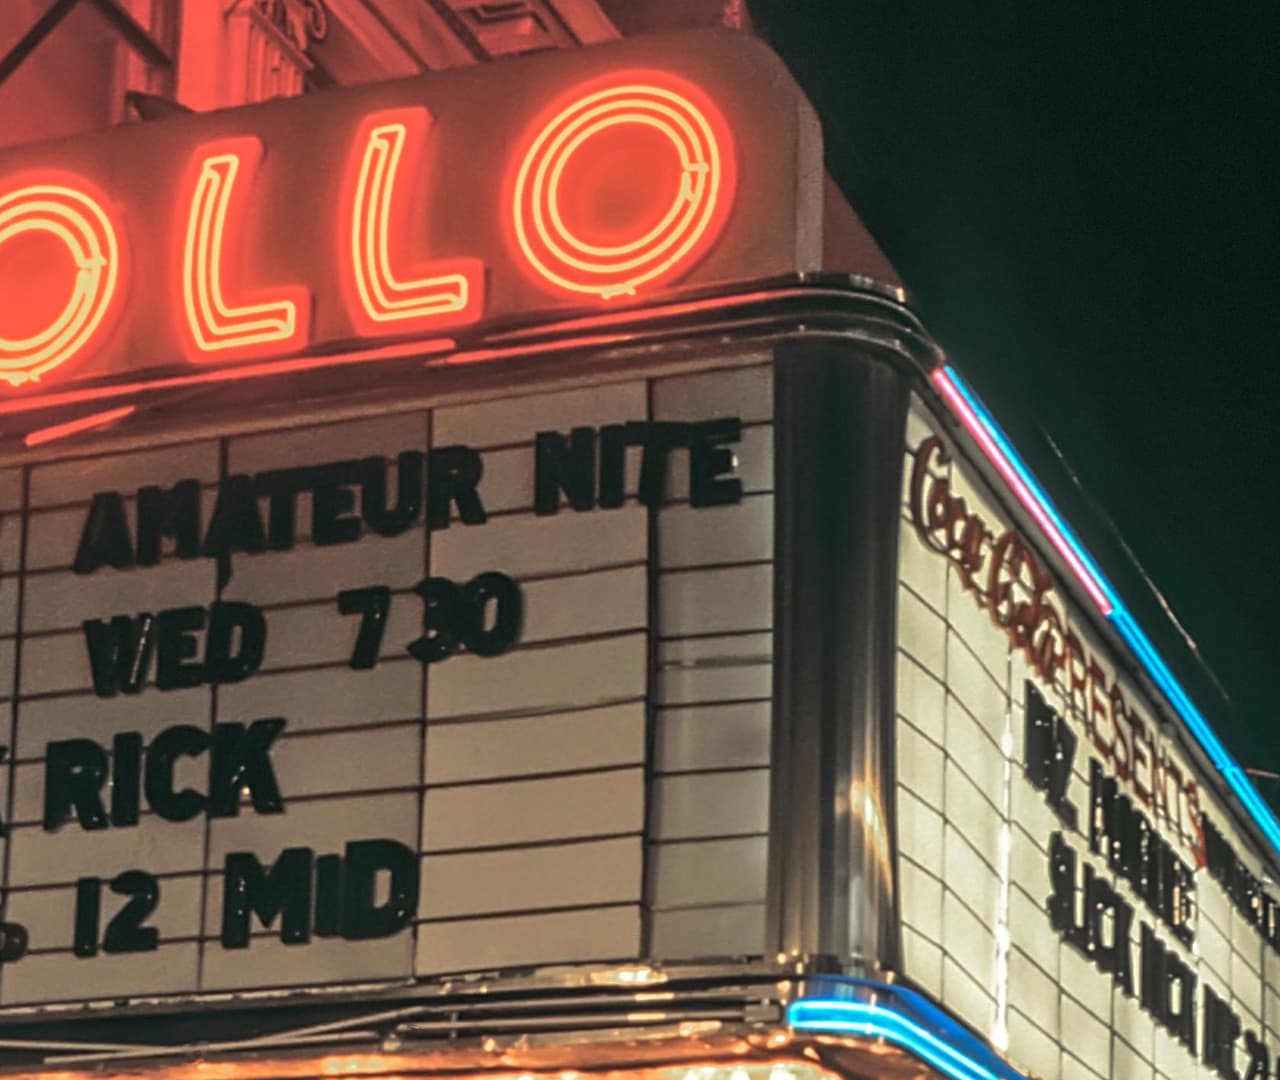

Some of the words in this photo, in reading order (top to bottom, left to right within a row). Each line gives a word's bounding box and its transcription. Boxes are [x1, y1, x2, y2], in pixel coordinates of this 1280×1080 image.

[74, 445, 488, 575] AMATEUR
[533, 417, 744, 516] NITE
[84, 601, 268, 698] WED
[43, 717, 287, 832] RICK
[74, 869, 160, 958] 12
[221, 838, 420, 950] MID
